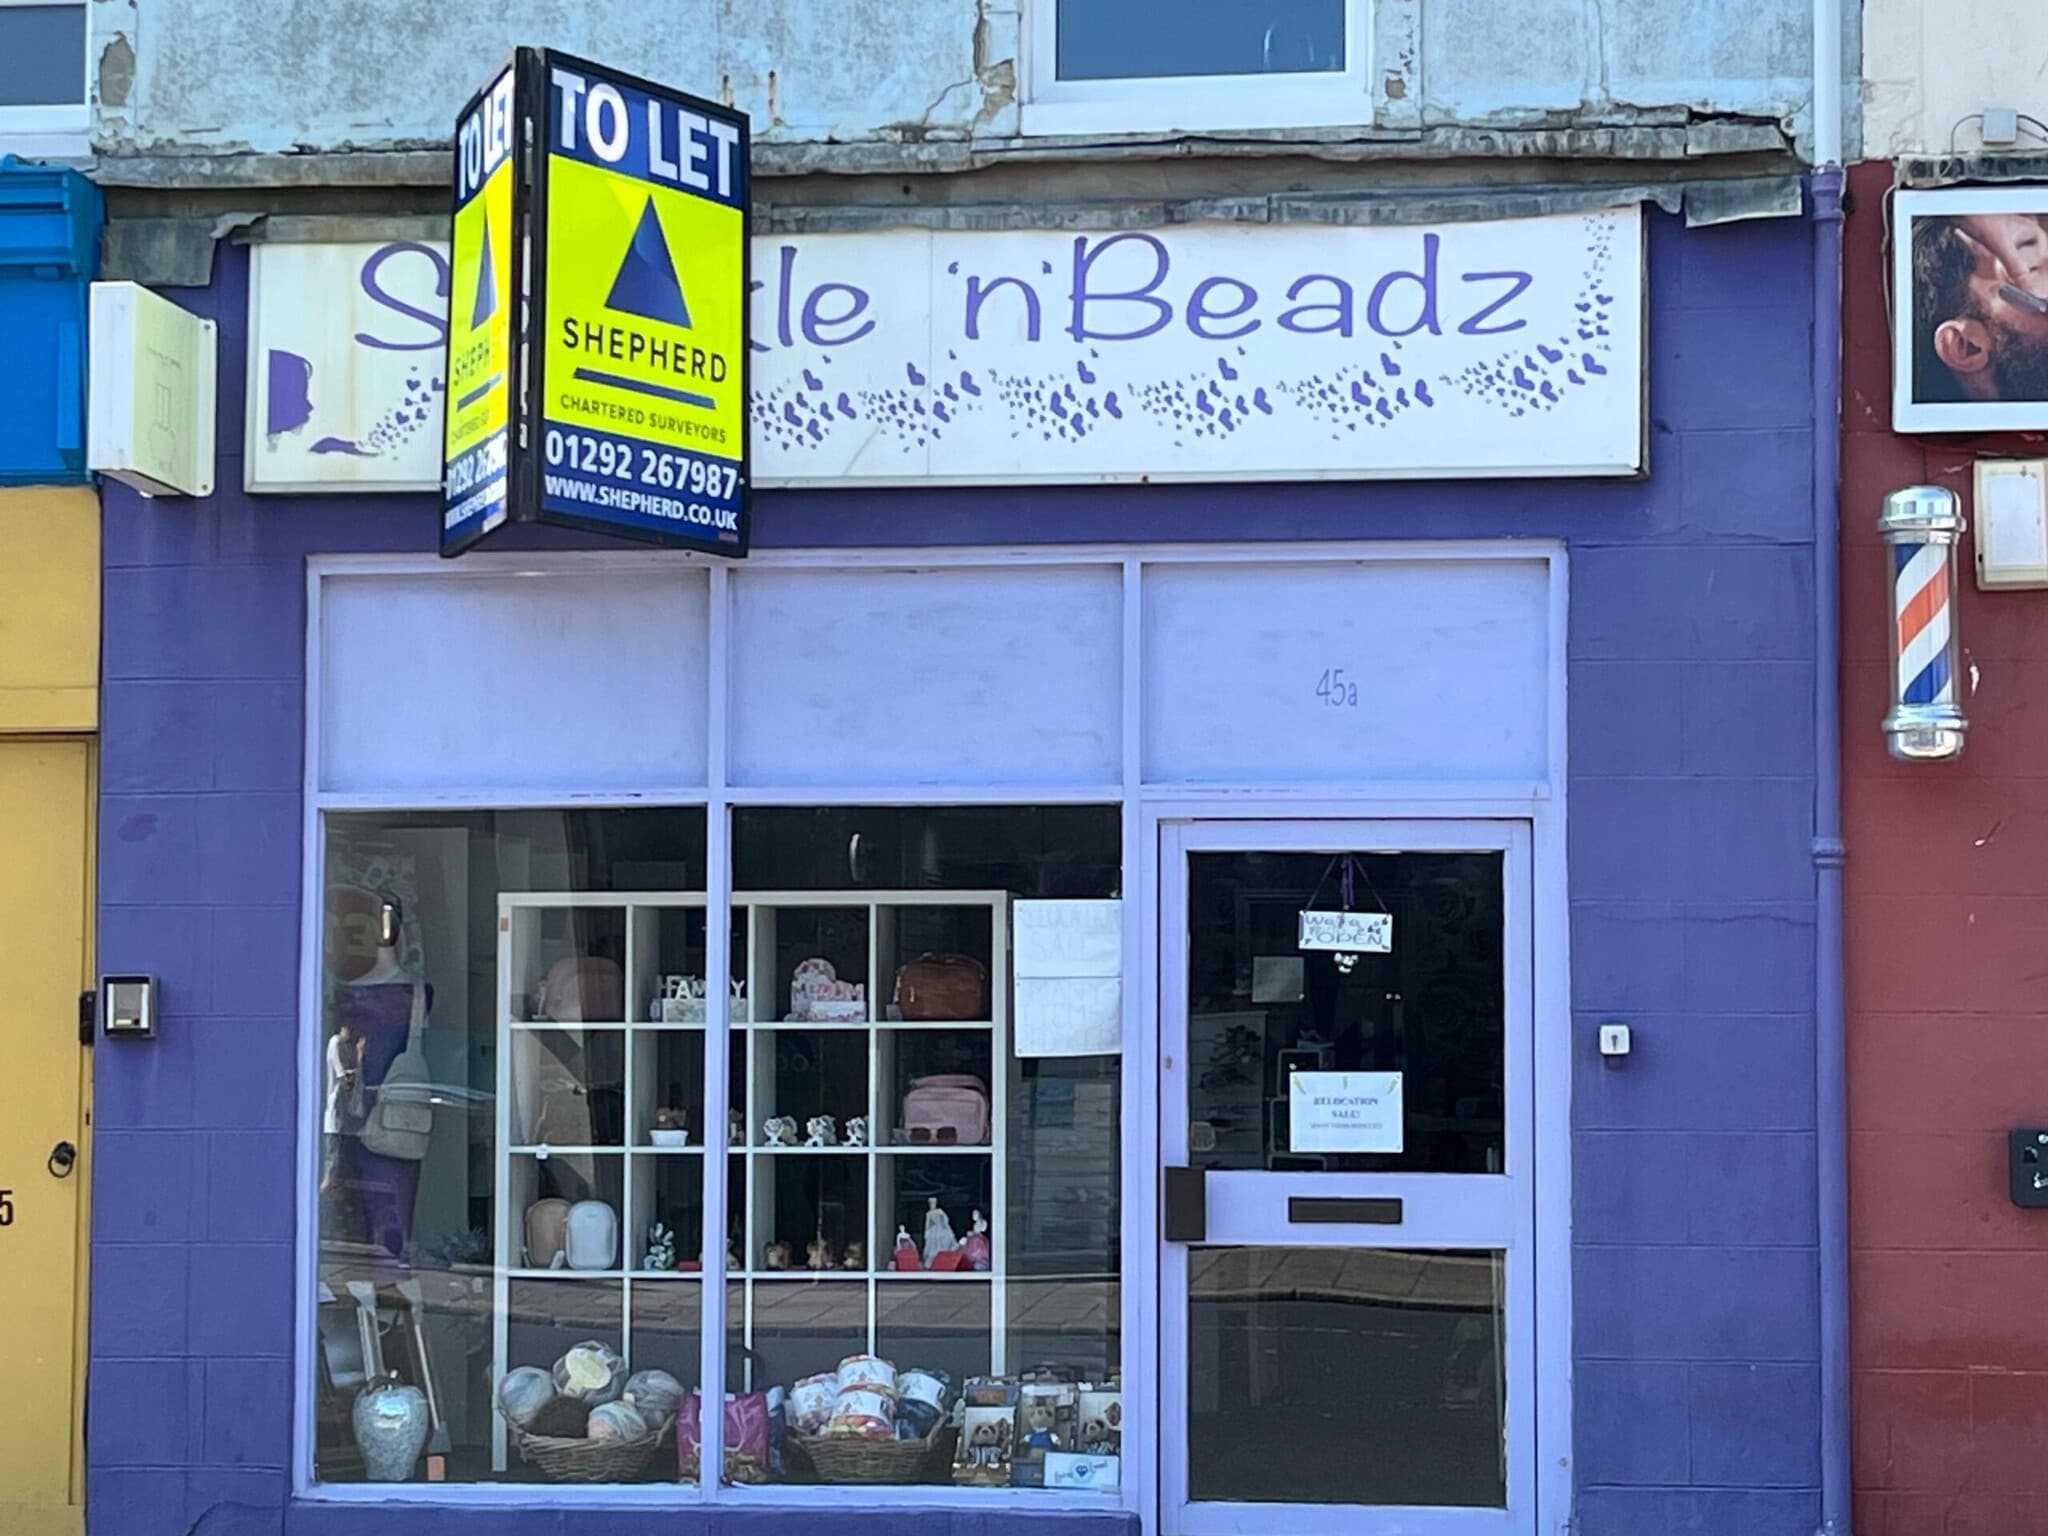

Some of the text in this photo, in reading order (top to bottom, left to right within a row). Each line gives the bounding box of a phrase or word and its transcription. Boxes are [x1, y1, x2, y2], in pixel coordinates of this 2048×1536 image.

[459, 70, 515, 200] TO LET
[552, 68, 739, 198] TO LET
[562, 317, 727, 384] SHEPHERD
[560, 394, 727, 444] CHARTERED SURVEYORS
[545, 430, 633, 480] 01292
[641, 449, 739, 500] 267987
[543, 474, 739, 532] WWW.SHEPHERD.CO.UK
[1315, 668, 1358, 707] 45a
